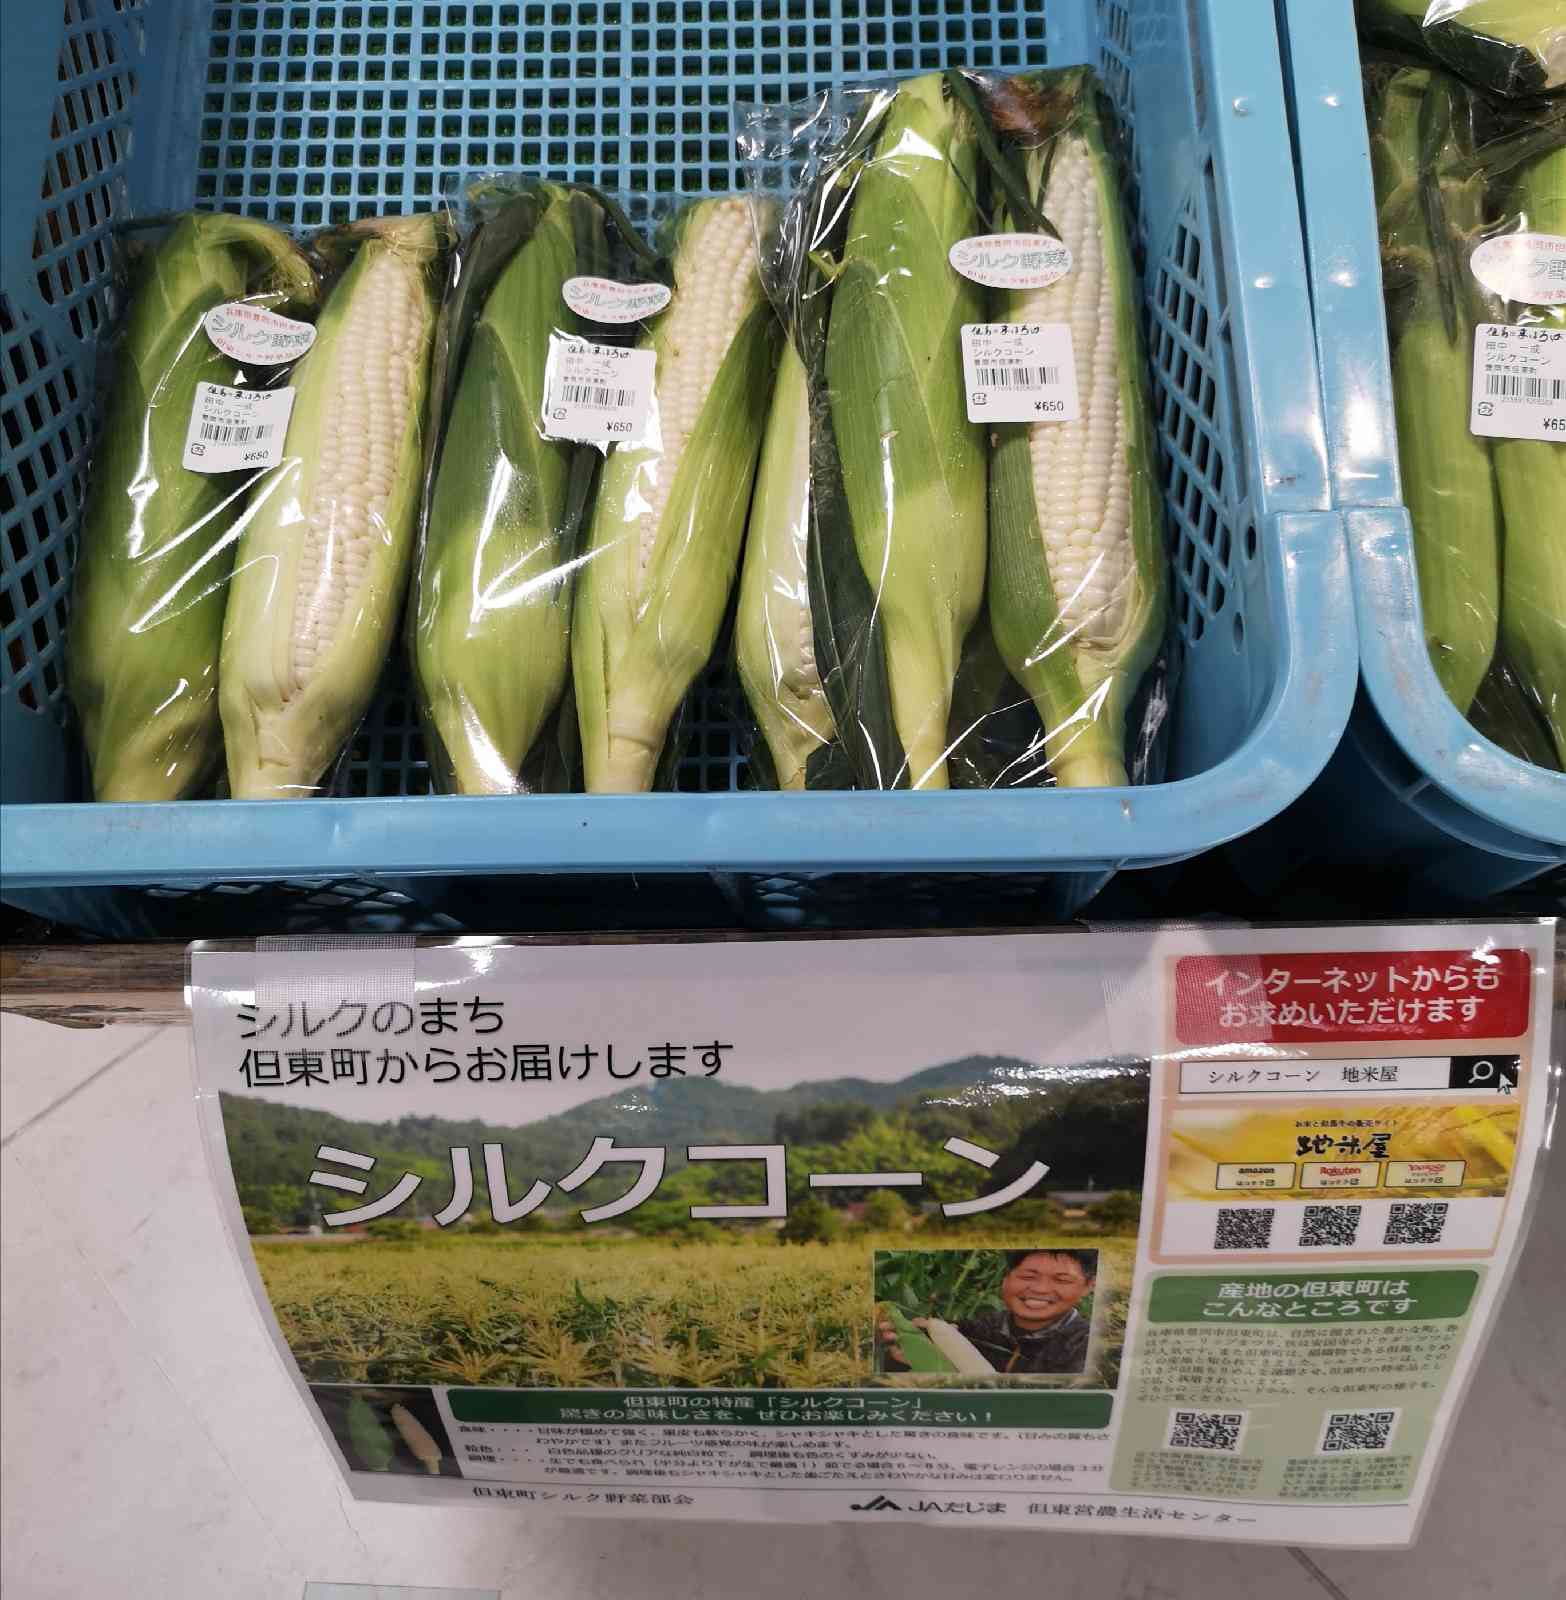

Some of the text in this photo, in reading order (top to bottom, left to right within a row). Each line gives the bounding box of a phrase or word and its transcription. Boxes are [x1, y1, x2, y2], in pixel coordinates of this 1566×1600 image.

[958, 249, 1070, 273] シルク野菜
[974, 348, 1035, 358] シルクコーン
[1486, 341, 1508, 350] 田中
[1487, 351, 1552, 366] シルクコーン
[566, 366, 619, 378] シルクコーン
[204, 406, 258, 419] シルクコーン
[1034, 400, 1064, 412] ¥650
[606, 421, 633, 434] ¥650
[243, 450, 270, 461] ¥650
[1206, 963, 1500, 997] インターネットからも
[235, 994, 506, 1039] シルクのまち
[1218, 995, 1485, 1029] お求めいただけます
[238, 1039, 735, 1089] 但東町からお届けします
[1208, 1065, 1398, 1085] シルクコーン 地米屋
[1296, 1132, 1392, 1160] 地米屋
[1237, 1166, 1276, 1175] amazon
[1319, 1166, 1362, 1176] Rakuten
[307, 1135, 1051, 1228] シルクコーン
[1216, 1279, 1410, 1300] 産地の但東町は
[1201, 1298, 1418, 1318] こんなところです
[623, 1395, 922, 1410] 但東町の特産「シルクコーン」
[560, 1406, 992, 1423] 驚きの美味しさを、ぜひお楽しみください！
[472, 1485, 695, 1505] 但東町シルク野菜部会
[908, 1499, 1007, 1514] JAたじま
[1028, 1500, 1257, 1524] 但東営農生活センター
